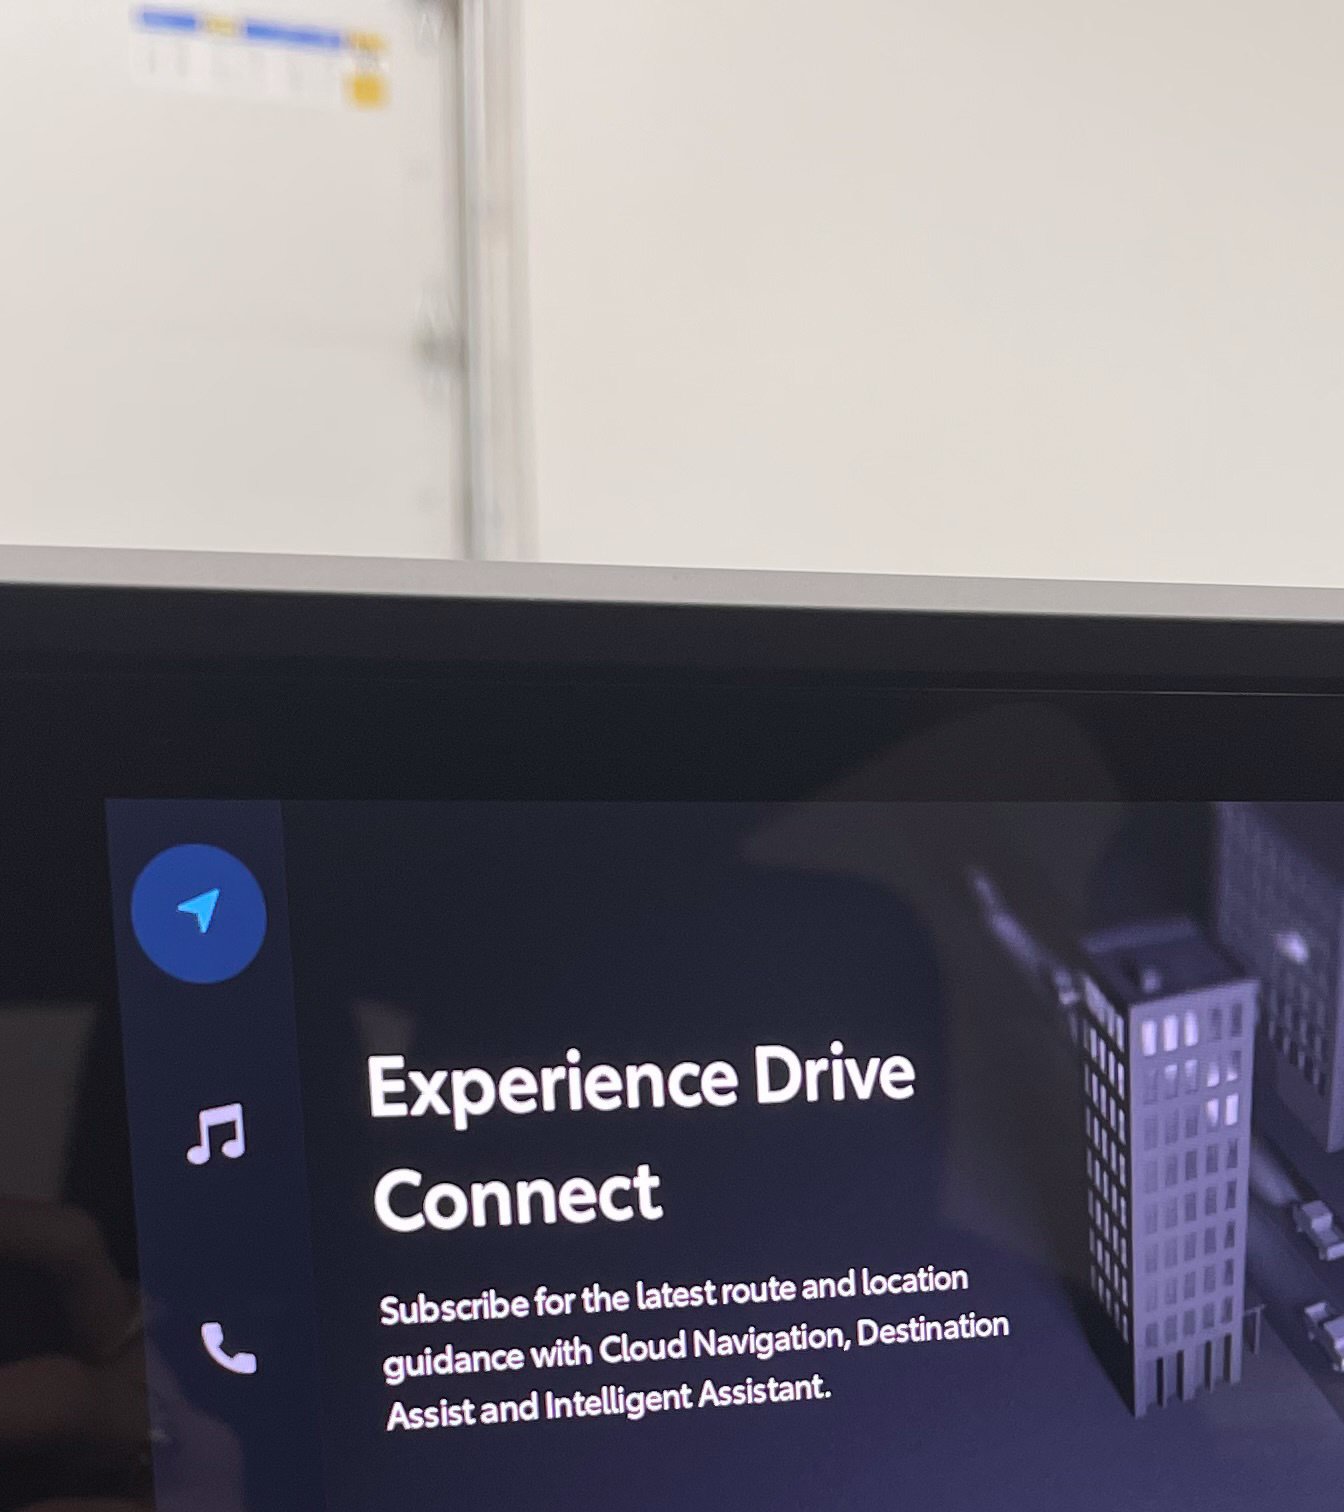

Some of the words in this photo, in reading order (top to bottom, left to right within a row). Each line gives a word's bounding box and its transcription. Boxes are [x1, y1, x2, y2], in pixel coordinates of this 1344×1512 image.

[368, 1047, 739, 1131] Experience
[755, 1040, 916, 1104] Drive
[374, 1164, 664, 1232] Connect
[380, 1288, 530, 1326] Subscribe
[533, 1285, 577, 1317] for
[580, 1282, 630, 1314] the
[636, 1279, 718, 1310] latest
[721, 1276, 797, 1305] route
[801, 1268, 856, 1300] and
[862, 1265, 969, 1296] location
[383, 1343, 525, 1386] guidance
[529, 1335, 593, 1369] with
[599, 1329, 687, 1364] Cloud
[693, 1323, 852, 1360] Navigation,
[857, 1311, 1010, 1346] Destination
[386, 1398, 477, 1432] Assist
[480, 1390, 539, 1424] and
[545, 1383, 694, 1420] Intelligent
[697, 1373, 832, 1408] Assistant.
